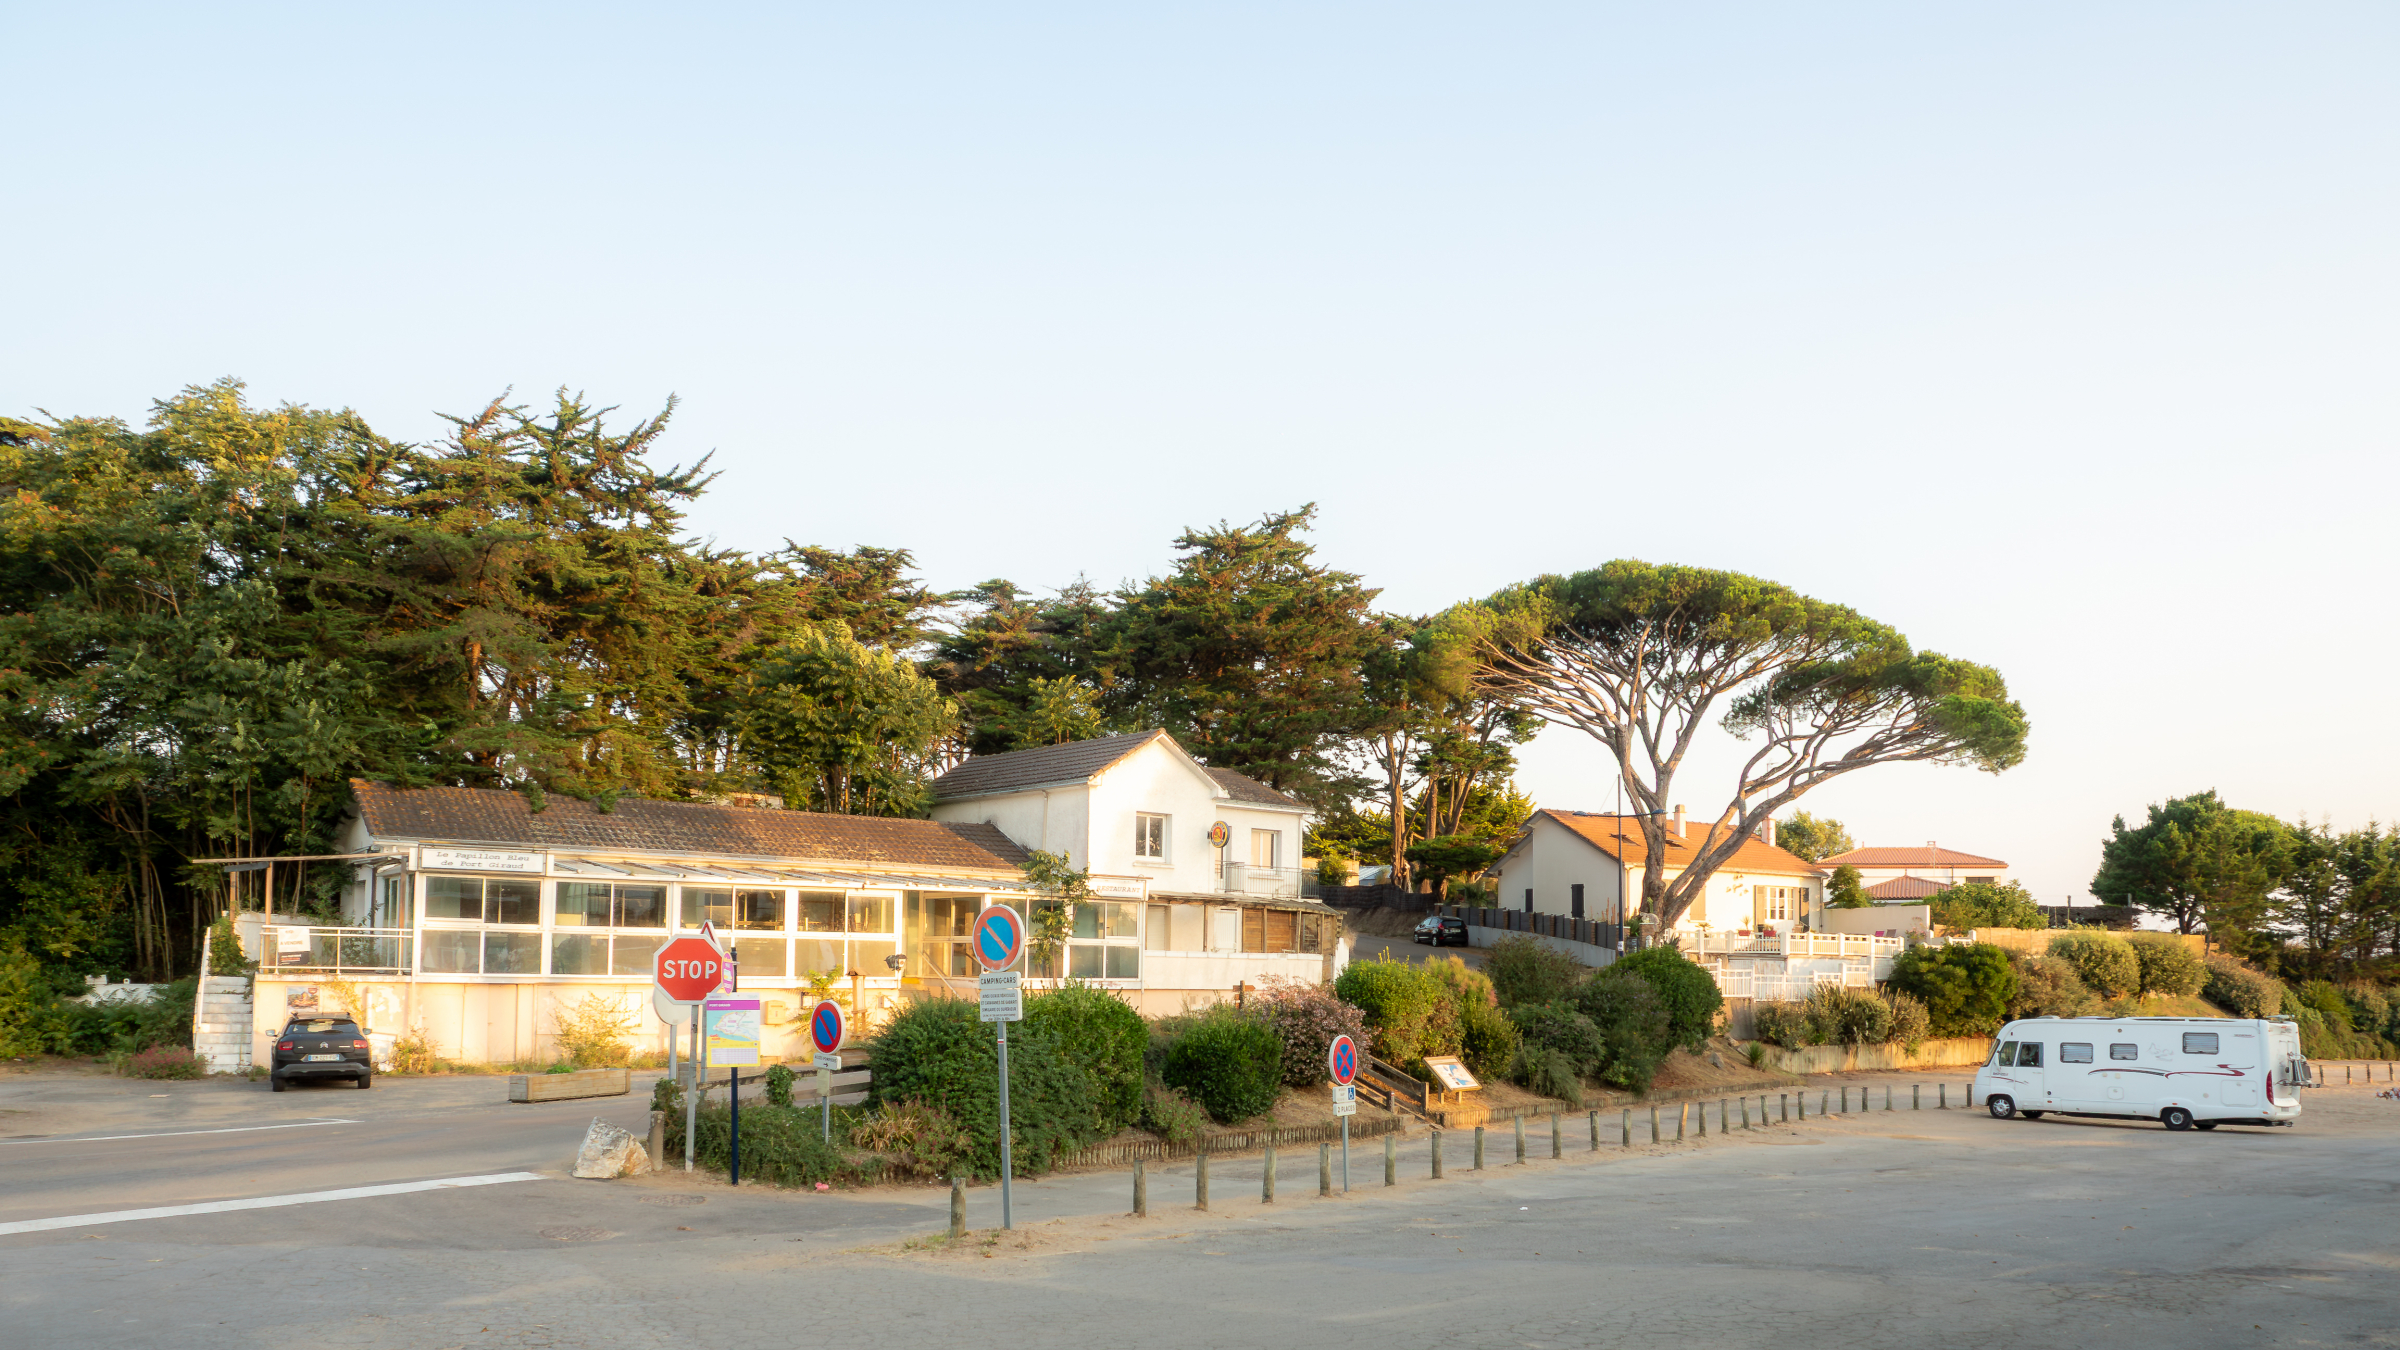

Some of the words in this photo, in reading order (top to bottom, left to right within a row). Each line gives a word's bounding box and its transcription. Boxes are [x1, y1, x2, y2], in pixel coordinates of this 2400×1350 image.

[455, 852, 501, 860] Papillon
[1096, 885, 1141, 894] RESTAURANT
[662, 960, 718, 979] STOP
[980, 976, 1016, 984] CAMPING-CARS
